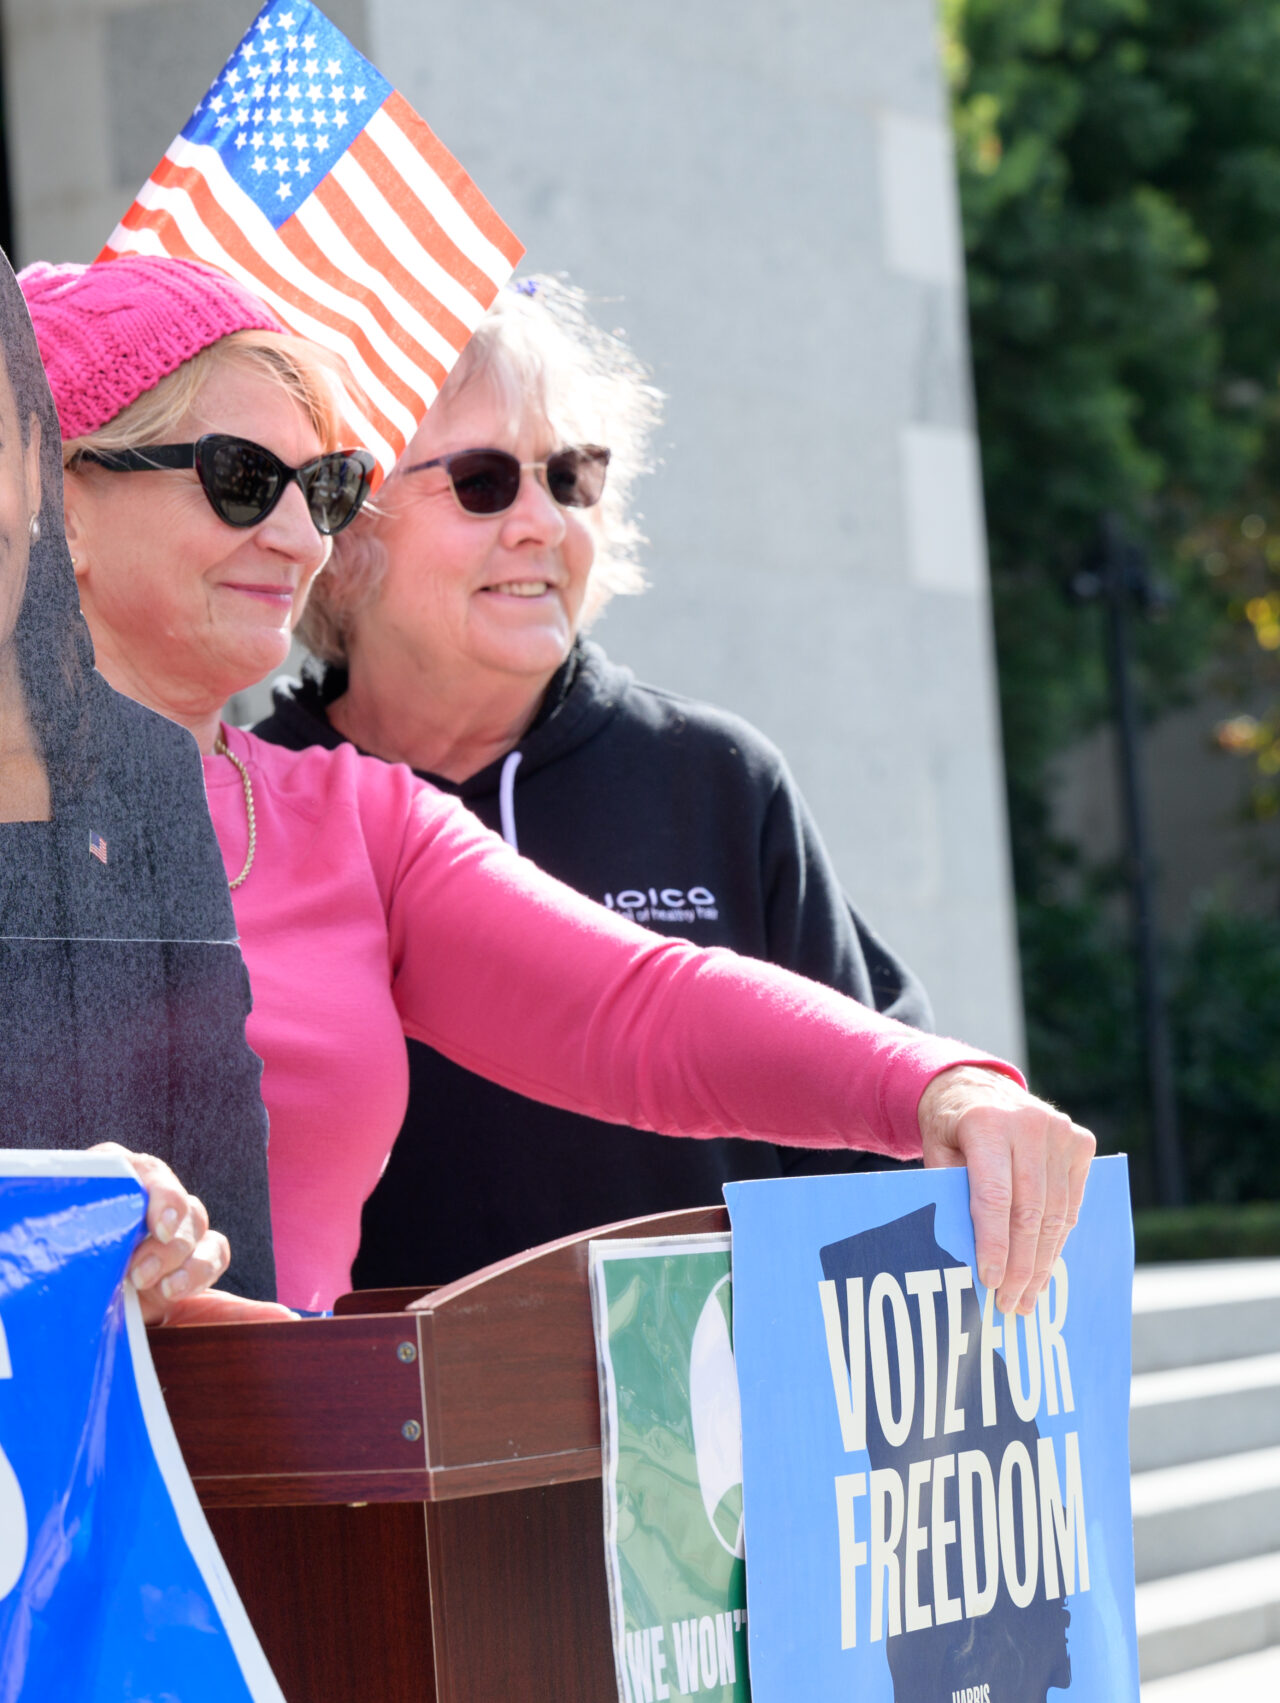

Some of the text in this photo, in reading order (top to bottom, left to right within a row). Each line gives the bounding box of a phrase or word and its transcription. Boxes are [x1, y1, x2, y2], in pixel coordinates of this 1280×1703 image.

[818, 1256, 1075, 1453] VOTE FOR
[834, 1431, 1090, 1651] FREEDOM
[625, 1625, 670, 1703] WE
